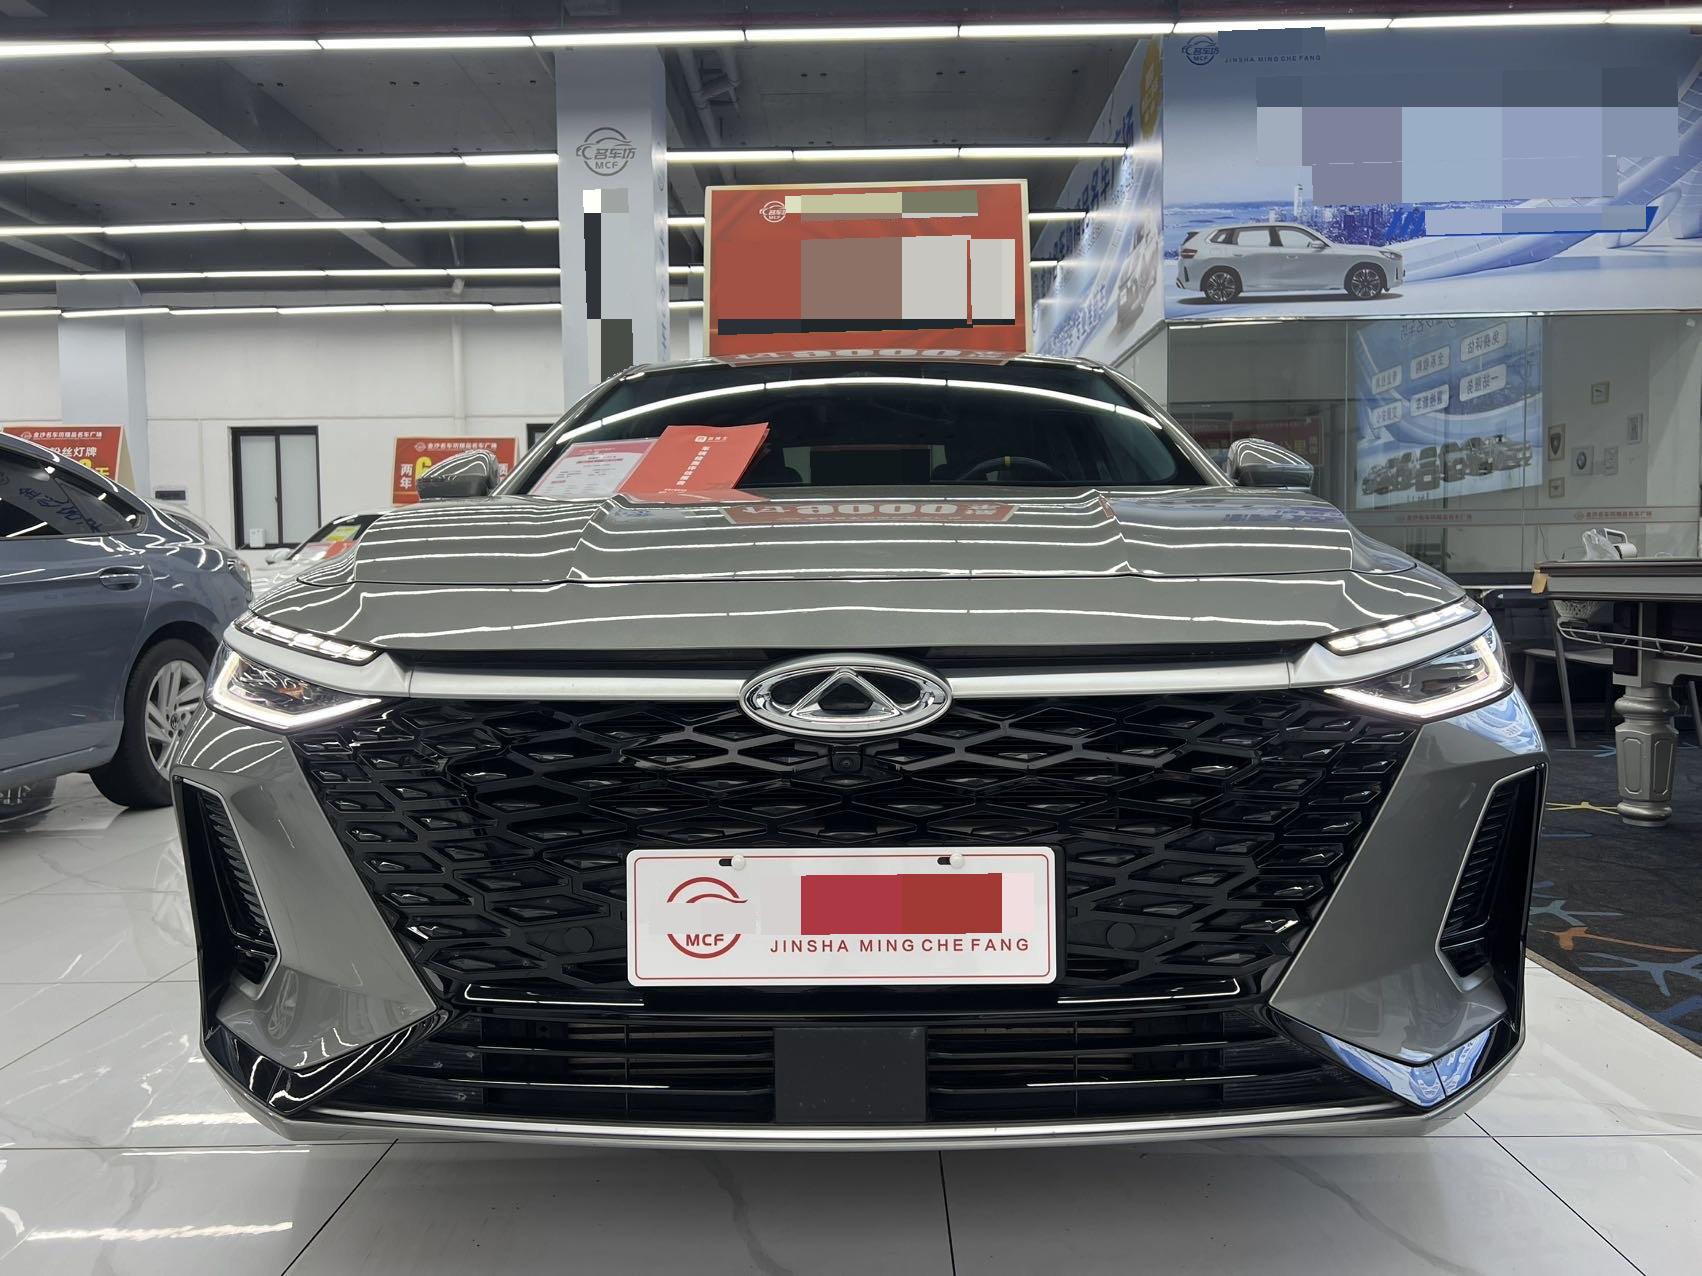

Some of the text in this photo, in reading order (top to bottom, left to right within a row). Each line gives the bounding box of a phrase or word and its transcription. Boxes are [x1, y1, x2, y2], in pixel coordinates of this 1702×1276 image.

[594, 147, 637, 160] 名车坊
[595, 161, 619, 169] MCF
[400, 463, 413, 489] 两年
[686, 934, 725, 946] MCF
[770, 938, 1030, 953] JINSHA MING CHE FANG
